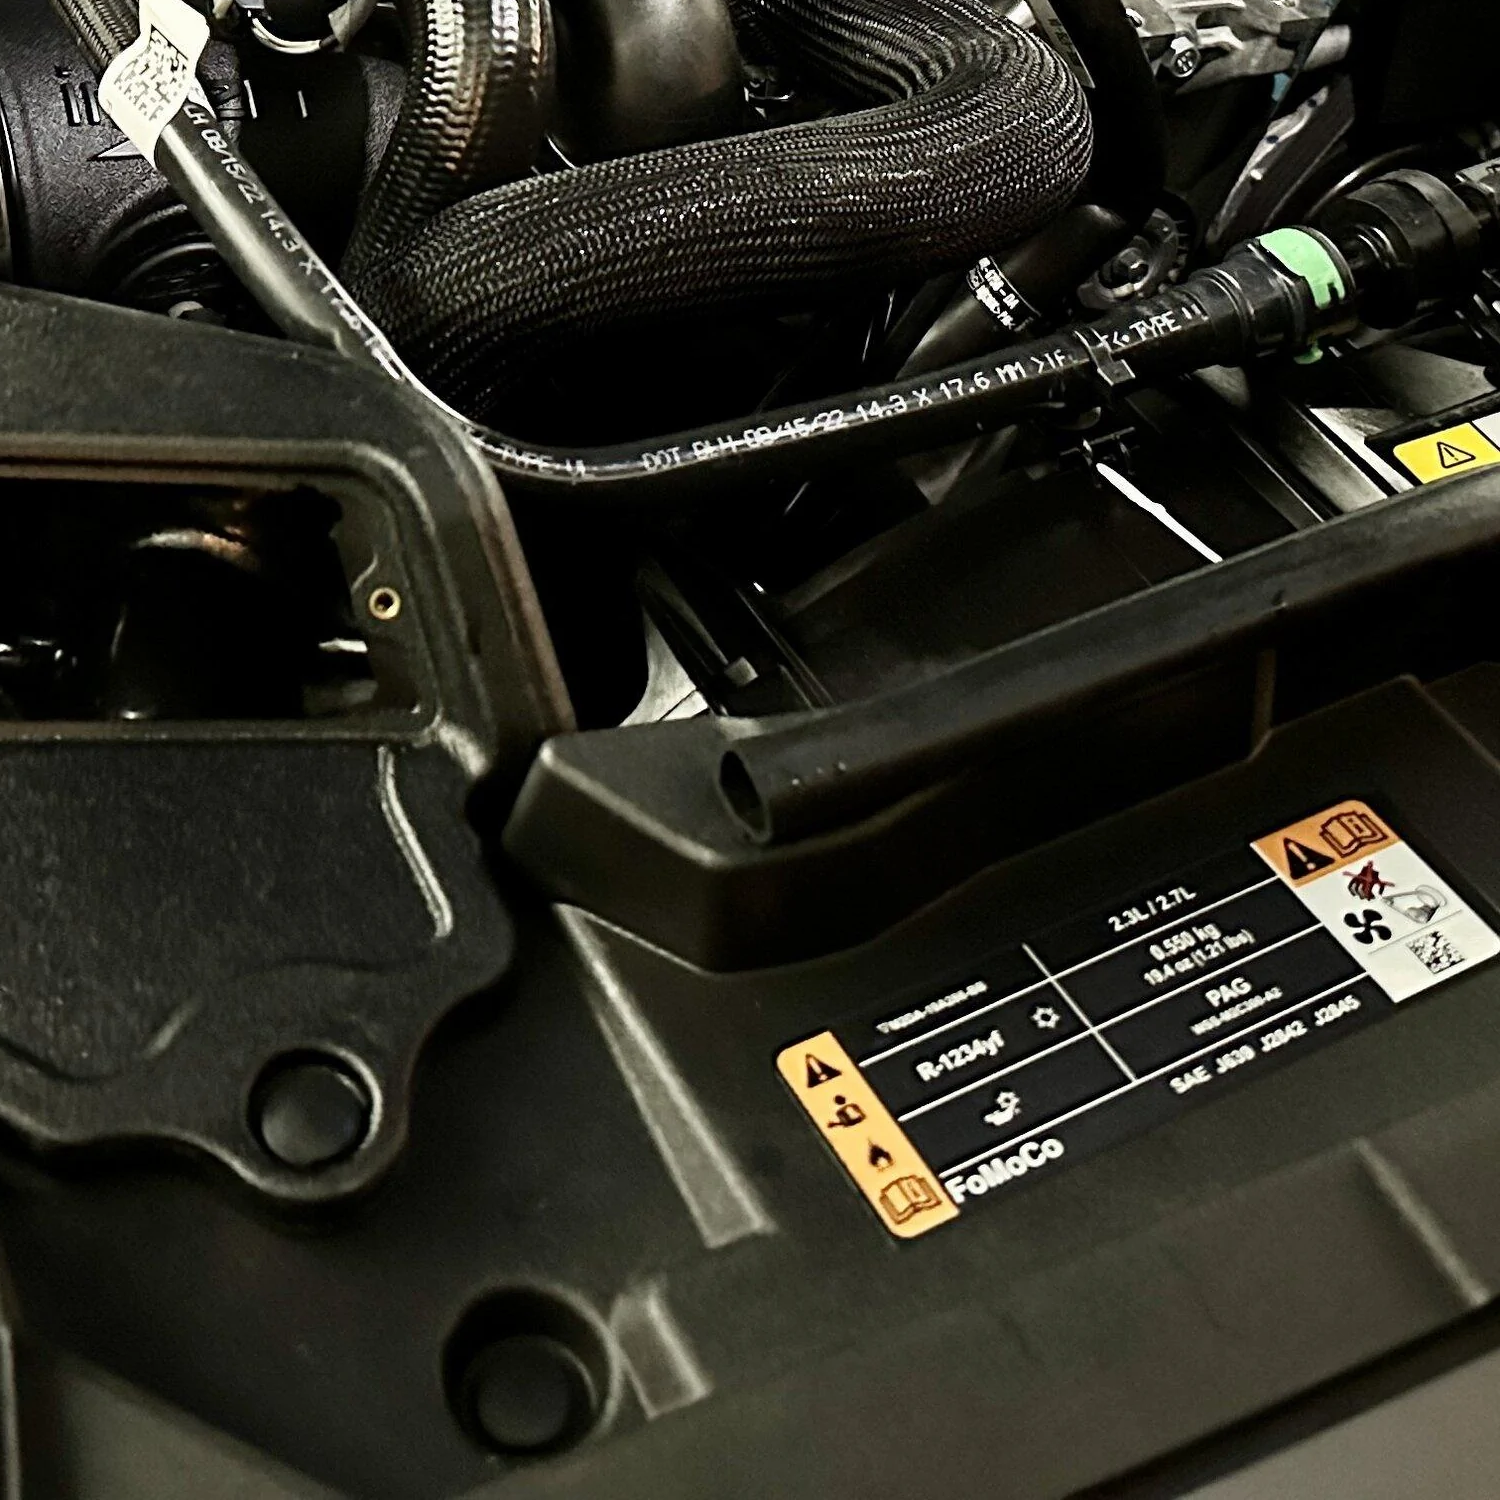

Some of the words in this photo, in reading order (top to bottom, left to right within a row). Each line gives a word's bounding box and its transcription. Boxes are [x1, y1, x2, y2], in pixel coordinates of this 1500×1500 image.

[200, 128, 266, 204] 08/15/22
[261, 210, 302, 253] 14.3
[641, 446, 681, 474] DOT
[856, 394, 908, 422] 14.3
[911, 387, 933, 409] X
[939, 371, 992, 402] 17.6
[1129, 310, 1182, 343] TYPE
[1107, 902, 1150, 933] 2.3L
[1155, 885, 1198, 911] 2.7L
[1149, 930, 1197, 961] 0.550
[1192, 923, 1222, 941] kg
[1190, 941, 1226, 968] (1.21
[1204, 976, 1253, 1008] PAG
[915, 1029, 1006, 1083] R-1234yf
[1168, 1064, 1213, 1095] SAE
[1215, 1043, 1257, 1074] J639
[944, 1138, 1066, 1204] FoMoCo
